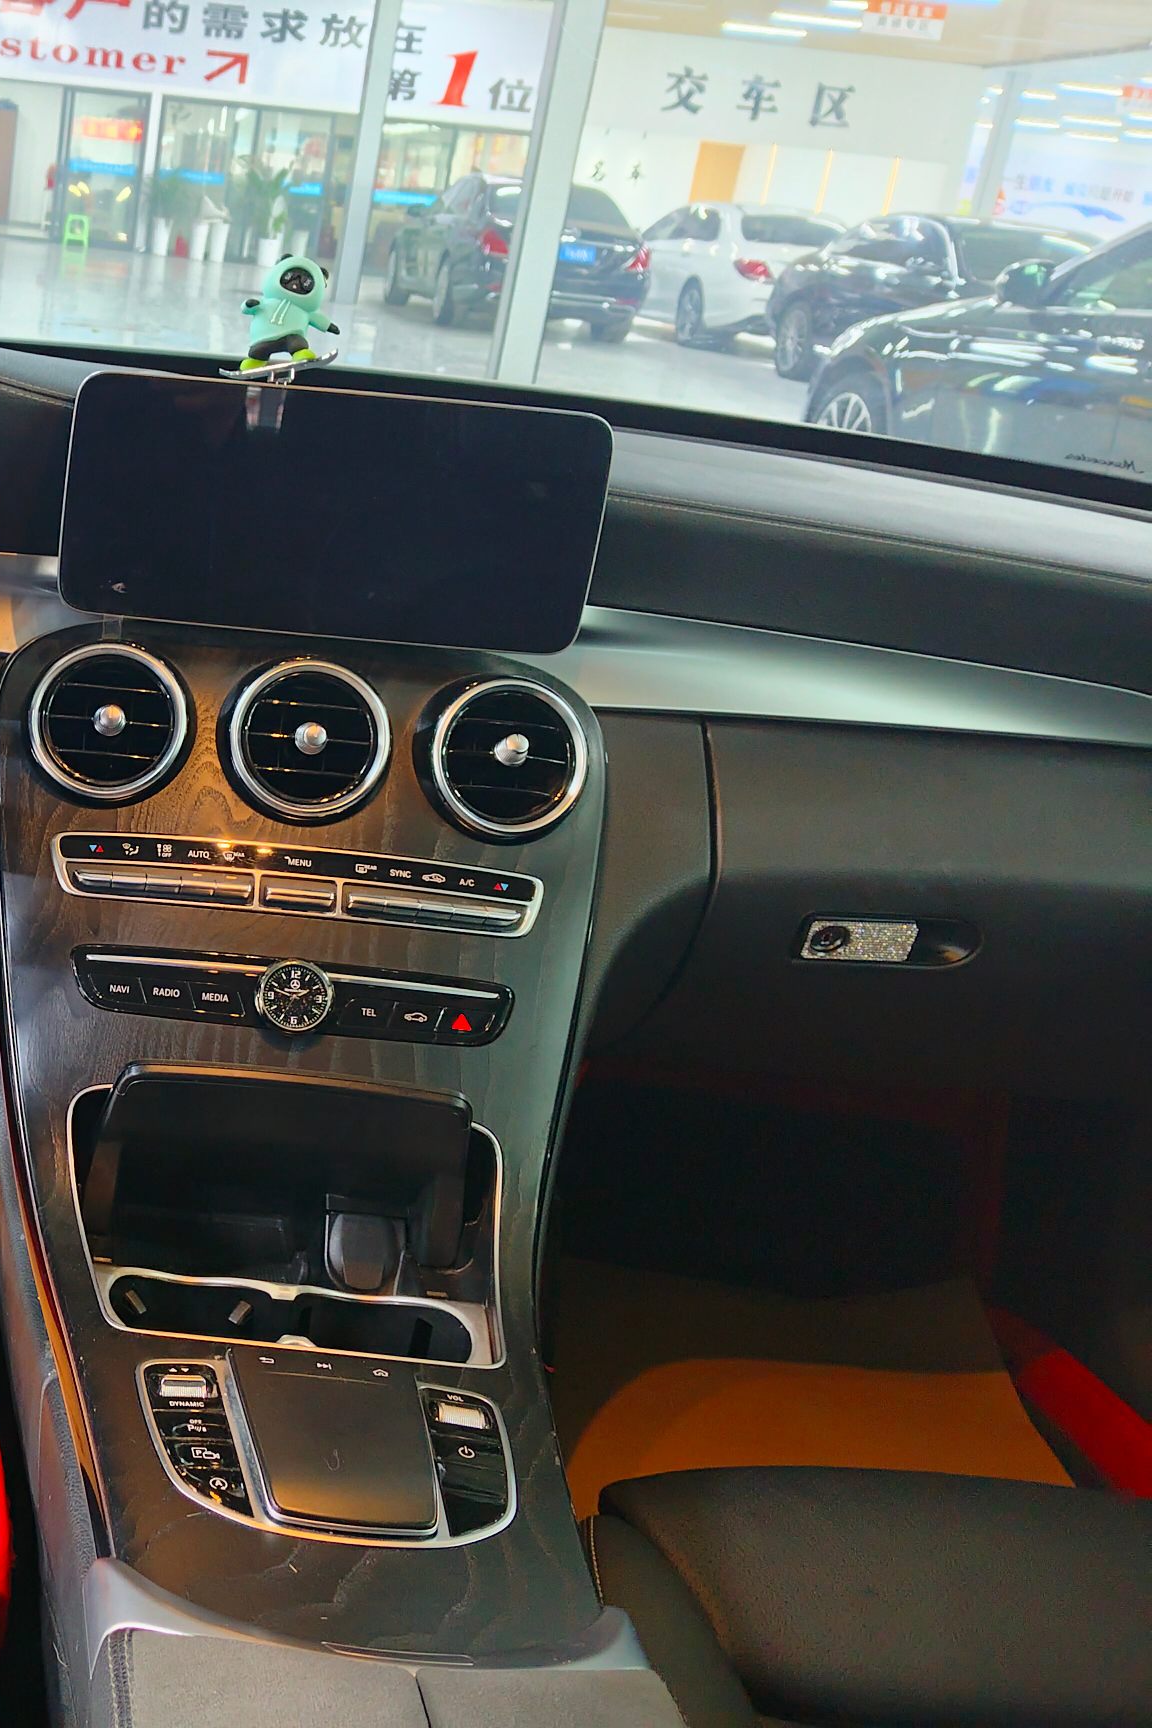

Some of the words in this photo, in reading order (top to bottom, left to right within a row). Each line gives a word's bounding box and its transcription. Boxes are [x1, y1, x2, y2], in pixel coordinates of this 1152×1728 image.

[660, 66, 856, 127] 交车区
[187, 850, 210, 859] AUTO
[287, 859, 312, 868] MENU
[389, 869, 412, 879] SYNC
[459, 878, 475, 887] A/C
[291, 970, 302, 979] 12
[109, 984, 130, 994] NAVI
[152, 987, 180, 998] RADIO
[201, 992, 229, 1003] MEDIA
[268, 991, 275, 1000] 9
[361, 1007, 377, 1017] TEL
[290, 1016, 298, 1025] 6
[447, 1394, 464, 1402] VOL
